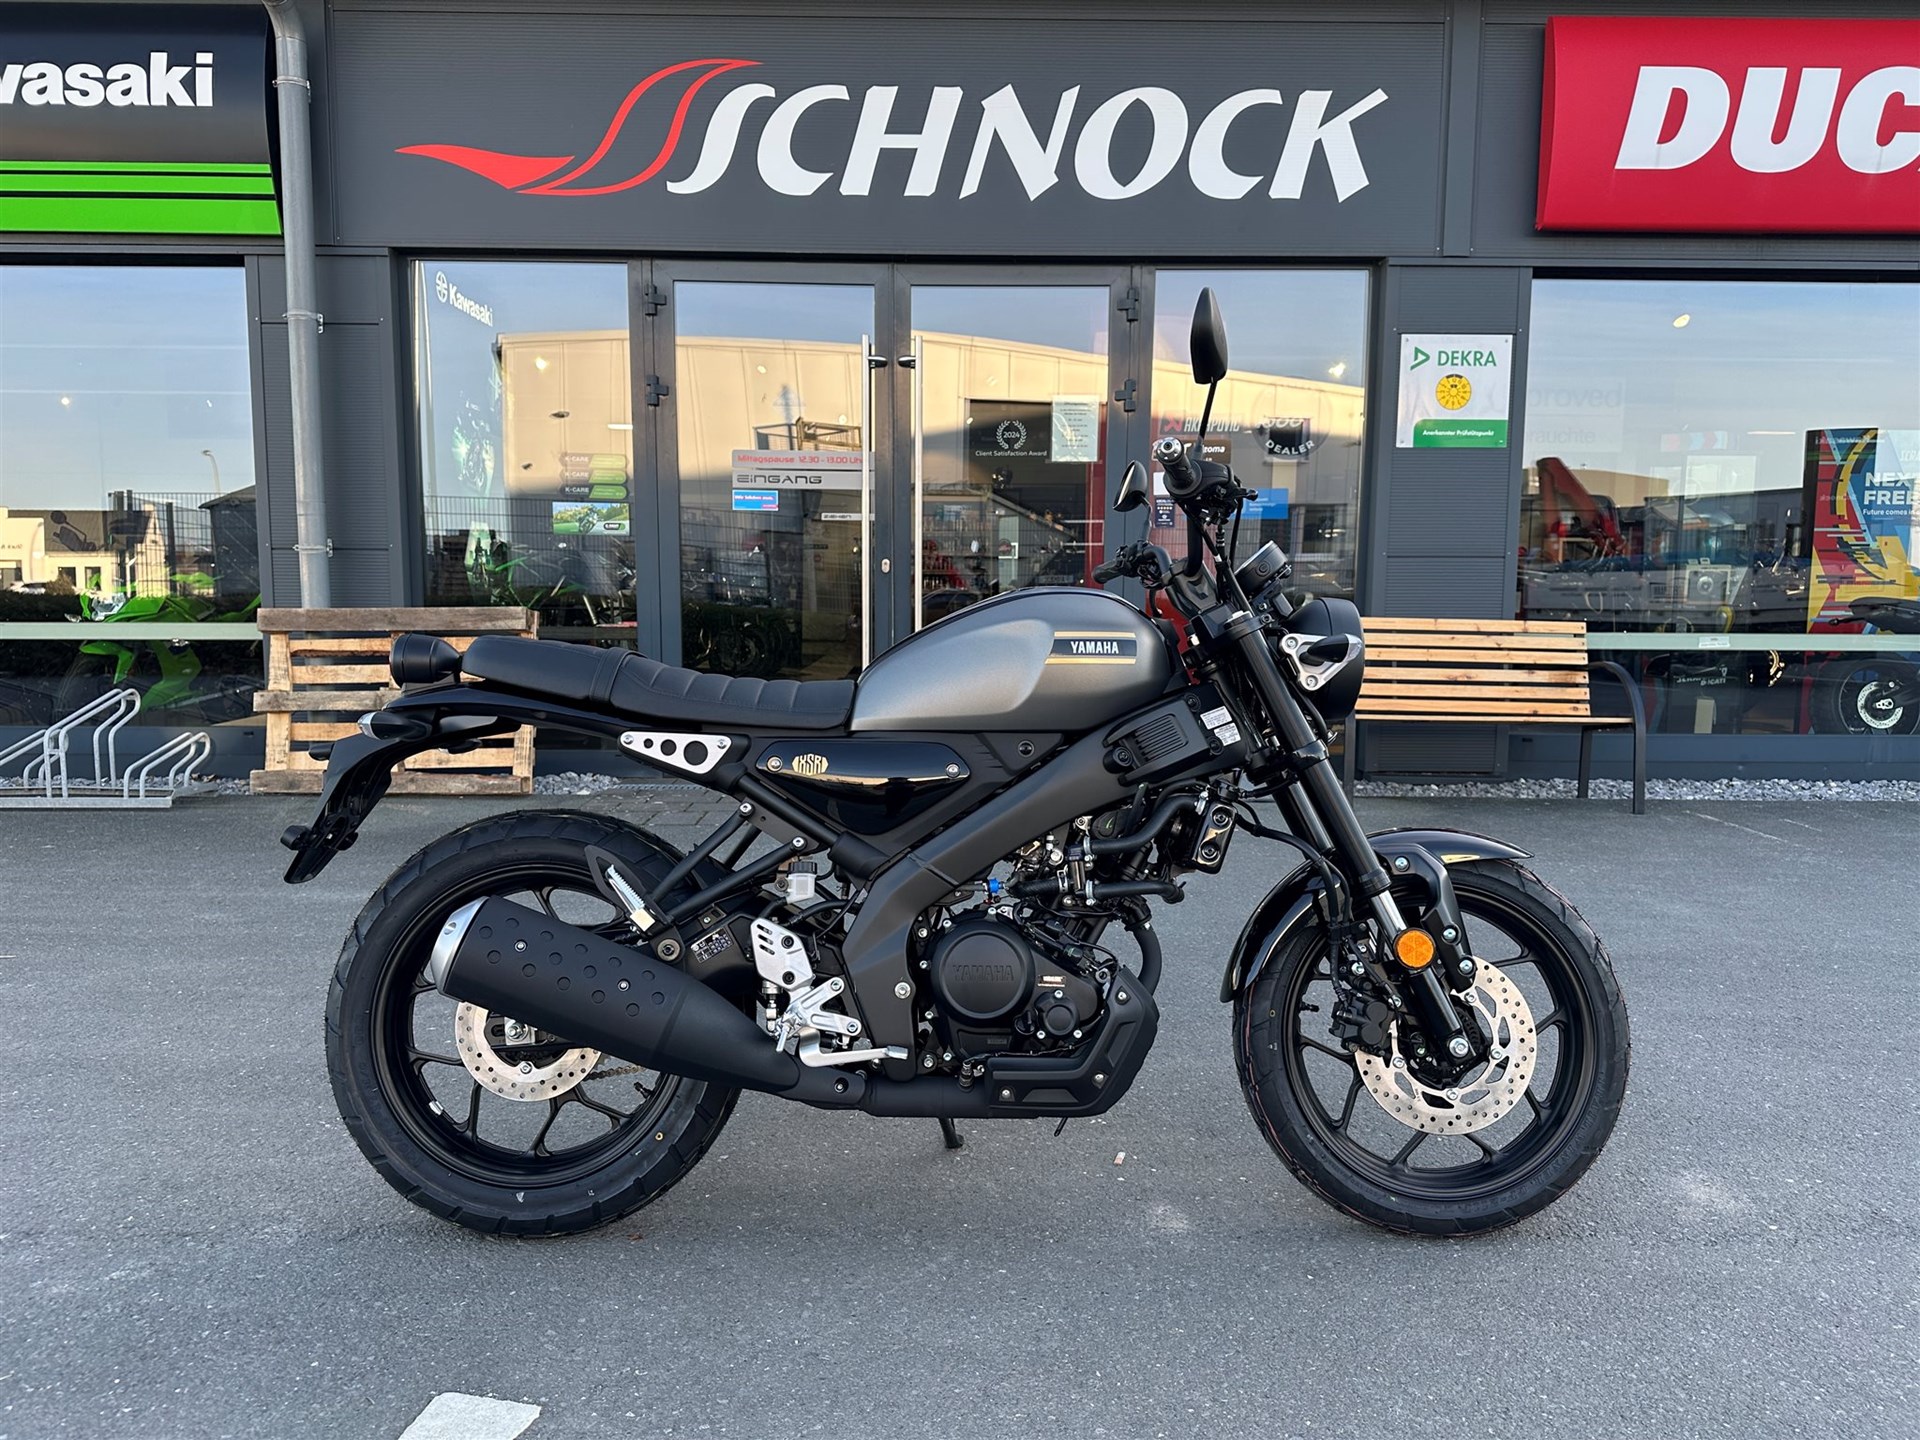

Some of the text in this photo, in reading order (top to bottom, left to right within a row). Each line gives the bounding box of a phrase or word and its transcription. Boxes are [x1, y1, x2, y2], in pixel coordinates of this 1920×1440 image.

[1614, 66, 1920, 174] DUC
[666, 83, 1389, 203] SCHNOCK
[449, 283, 494, 327] Kawasaki
[1437, 350, 1497, 367] DEKRA
[1003, 431, 1020, 439] 2024
[1265, 439, 1315, 456] DEALER
[737, 454, 795, 465] Mittagspause
[1862, 508, 1884, 516] Future
[1070, 641, 1120, 655] YAMAHA
[798, 753, 822, 776] XSR
[952, 964, 1014, 982] YAMAHA
